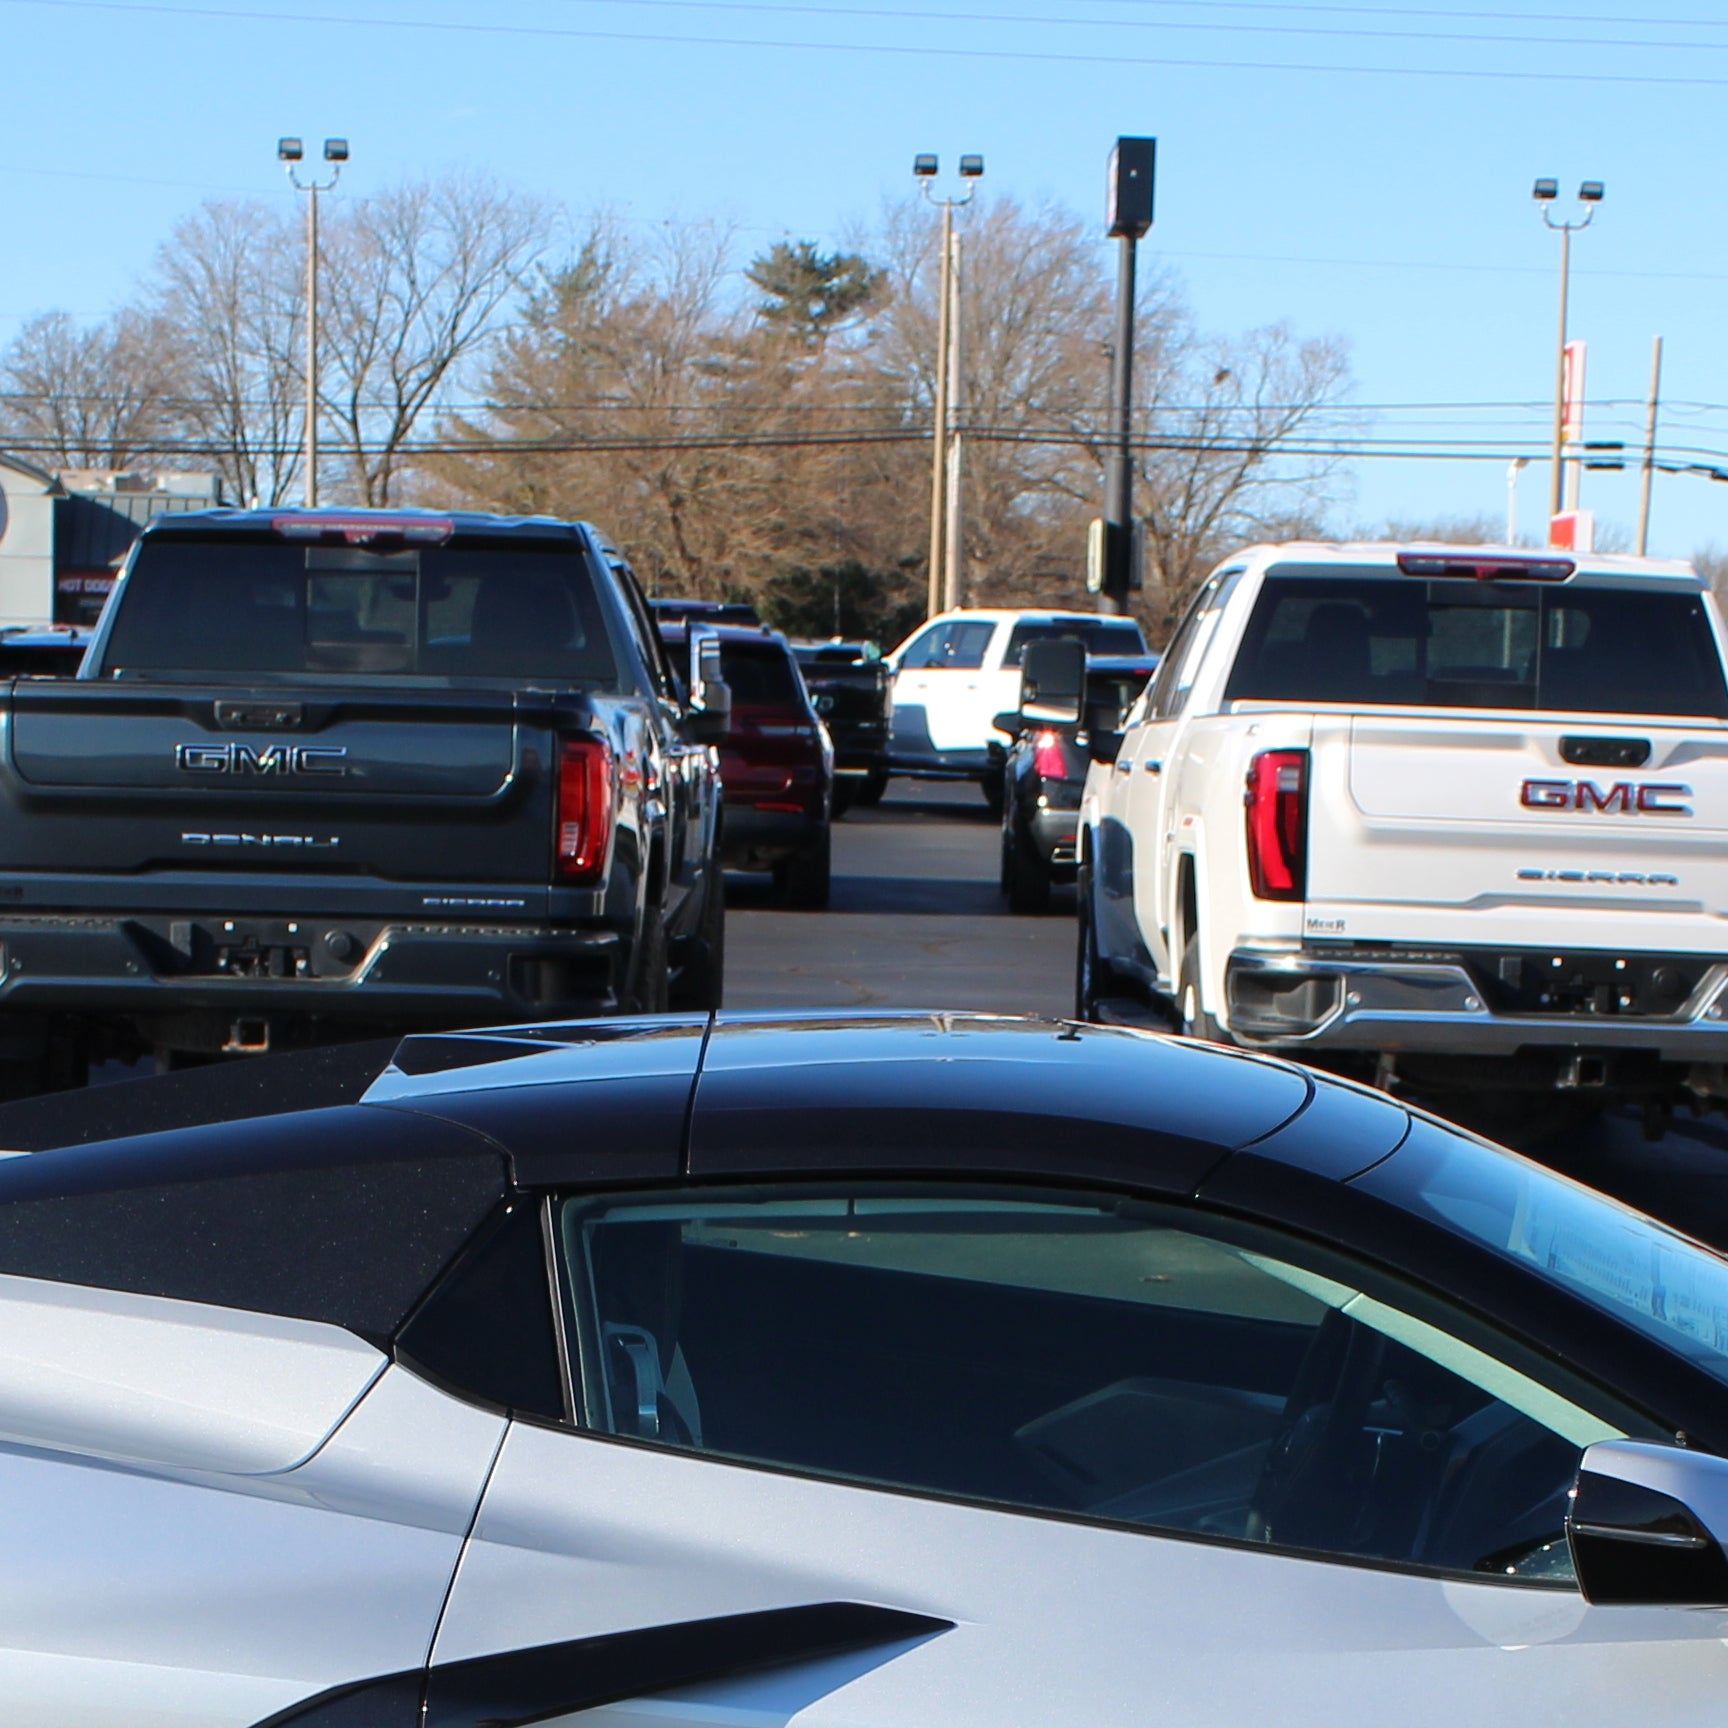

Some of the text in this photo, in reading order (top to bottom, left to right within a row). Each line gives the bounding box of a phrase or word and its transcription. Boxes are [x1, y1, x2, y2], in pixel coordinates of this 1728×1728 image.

[176, 743, 348, 777] GMC
[1519, 777, 1694, 816] GMC
[1515, 868, 1679, 886] SIERRA
